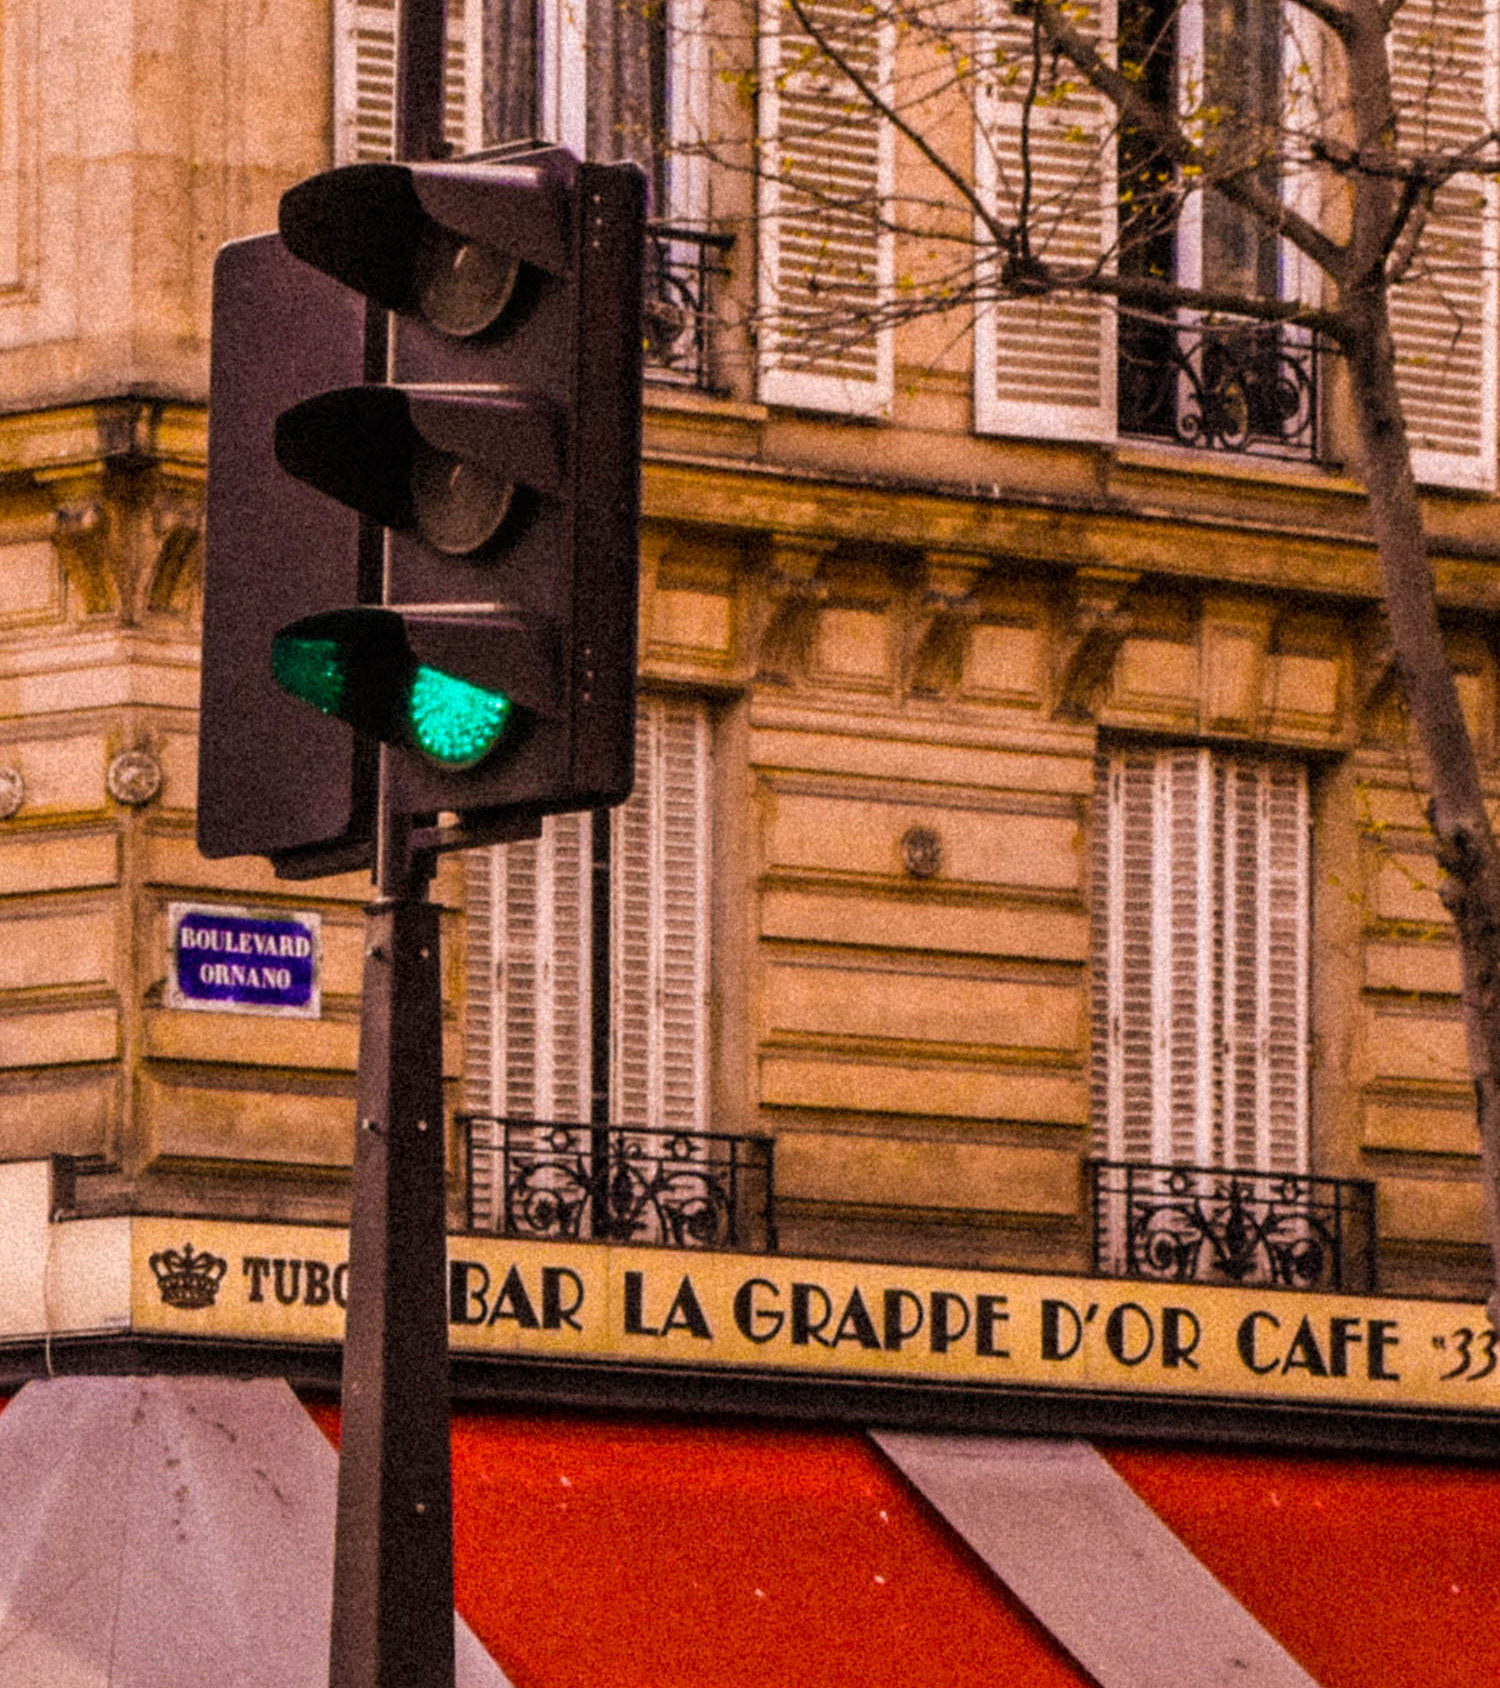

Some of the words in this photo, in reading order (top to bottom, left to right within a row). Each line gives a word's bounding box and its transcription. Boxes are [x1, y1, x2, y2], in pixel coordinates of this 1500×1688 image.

[180, 927, 310, 957] BOULEVARD
[200, 964, 291, 989] ORNANO
[242, 1256, 347, 1308] TUBO
[449, 1259, 585, 1333] BAR
[624, 1269, 713, 1340] LA
[733, 1276, 1010, 1359] GRAPPE
[1041, 1298, 1199, 1371] D'OR
[1237, 1311, 1403, 1381] CAFE
[1431, 1327, 1498, 1383] "33
